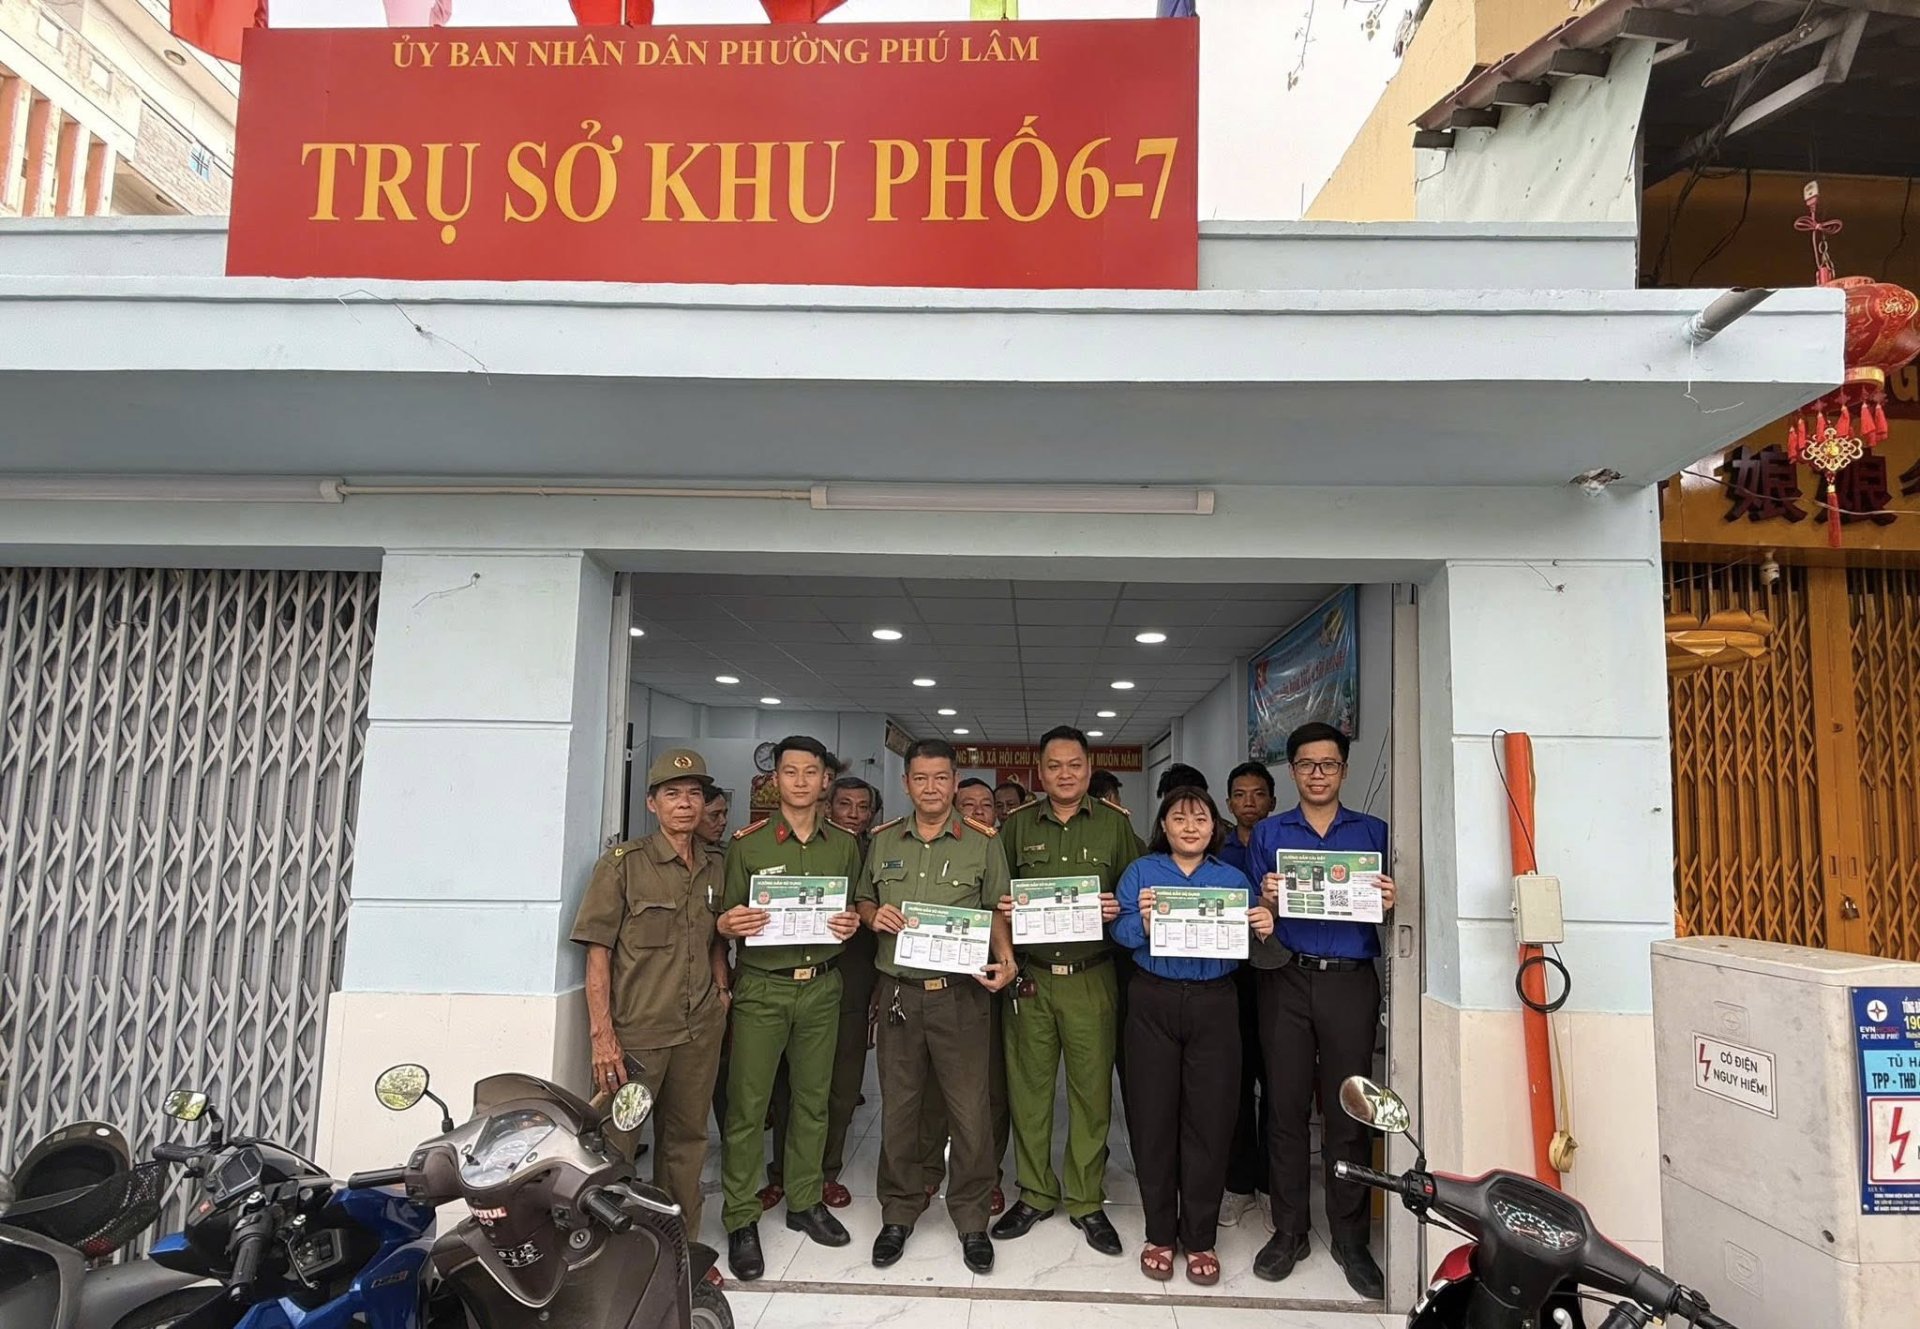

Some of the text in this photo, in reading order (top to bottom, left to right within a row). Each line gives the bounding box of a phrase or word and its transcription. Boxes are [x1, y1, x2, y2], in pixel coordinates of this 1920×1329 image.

[393, 30, 1039, 67] ỦY BAN NHÂN DÂN PHƯỜNG PHÚ LÂM
[302, 143, 480, 244] TRỤ
[505, 120, 623, 222] SỞ
[642, 141, 845, 223] KHU
[1720, 1051, 1758, 1073] CÓ ĐIỆN
[1909, 1056, 1920, 1068] H
[1713, 1068, 1768, 1097] NGUY HIỂM!
[1872, 1072, 1890, 1089] TPP
[1898, 1072, 1916, 1089] THĐ
